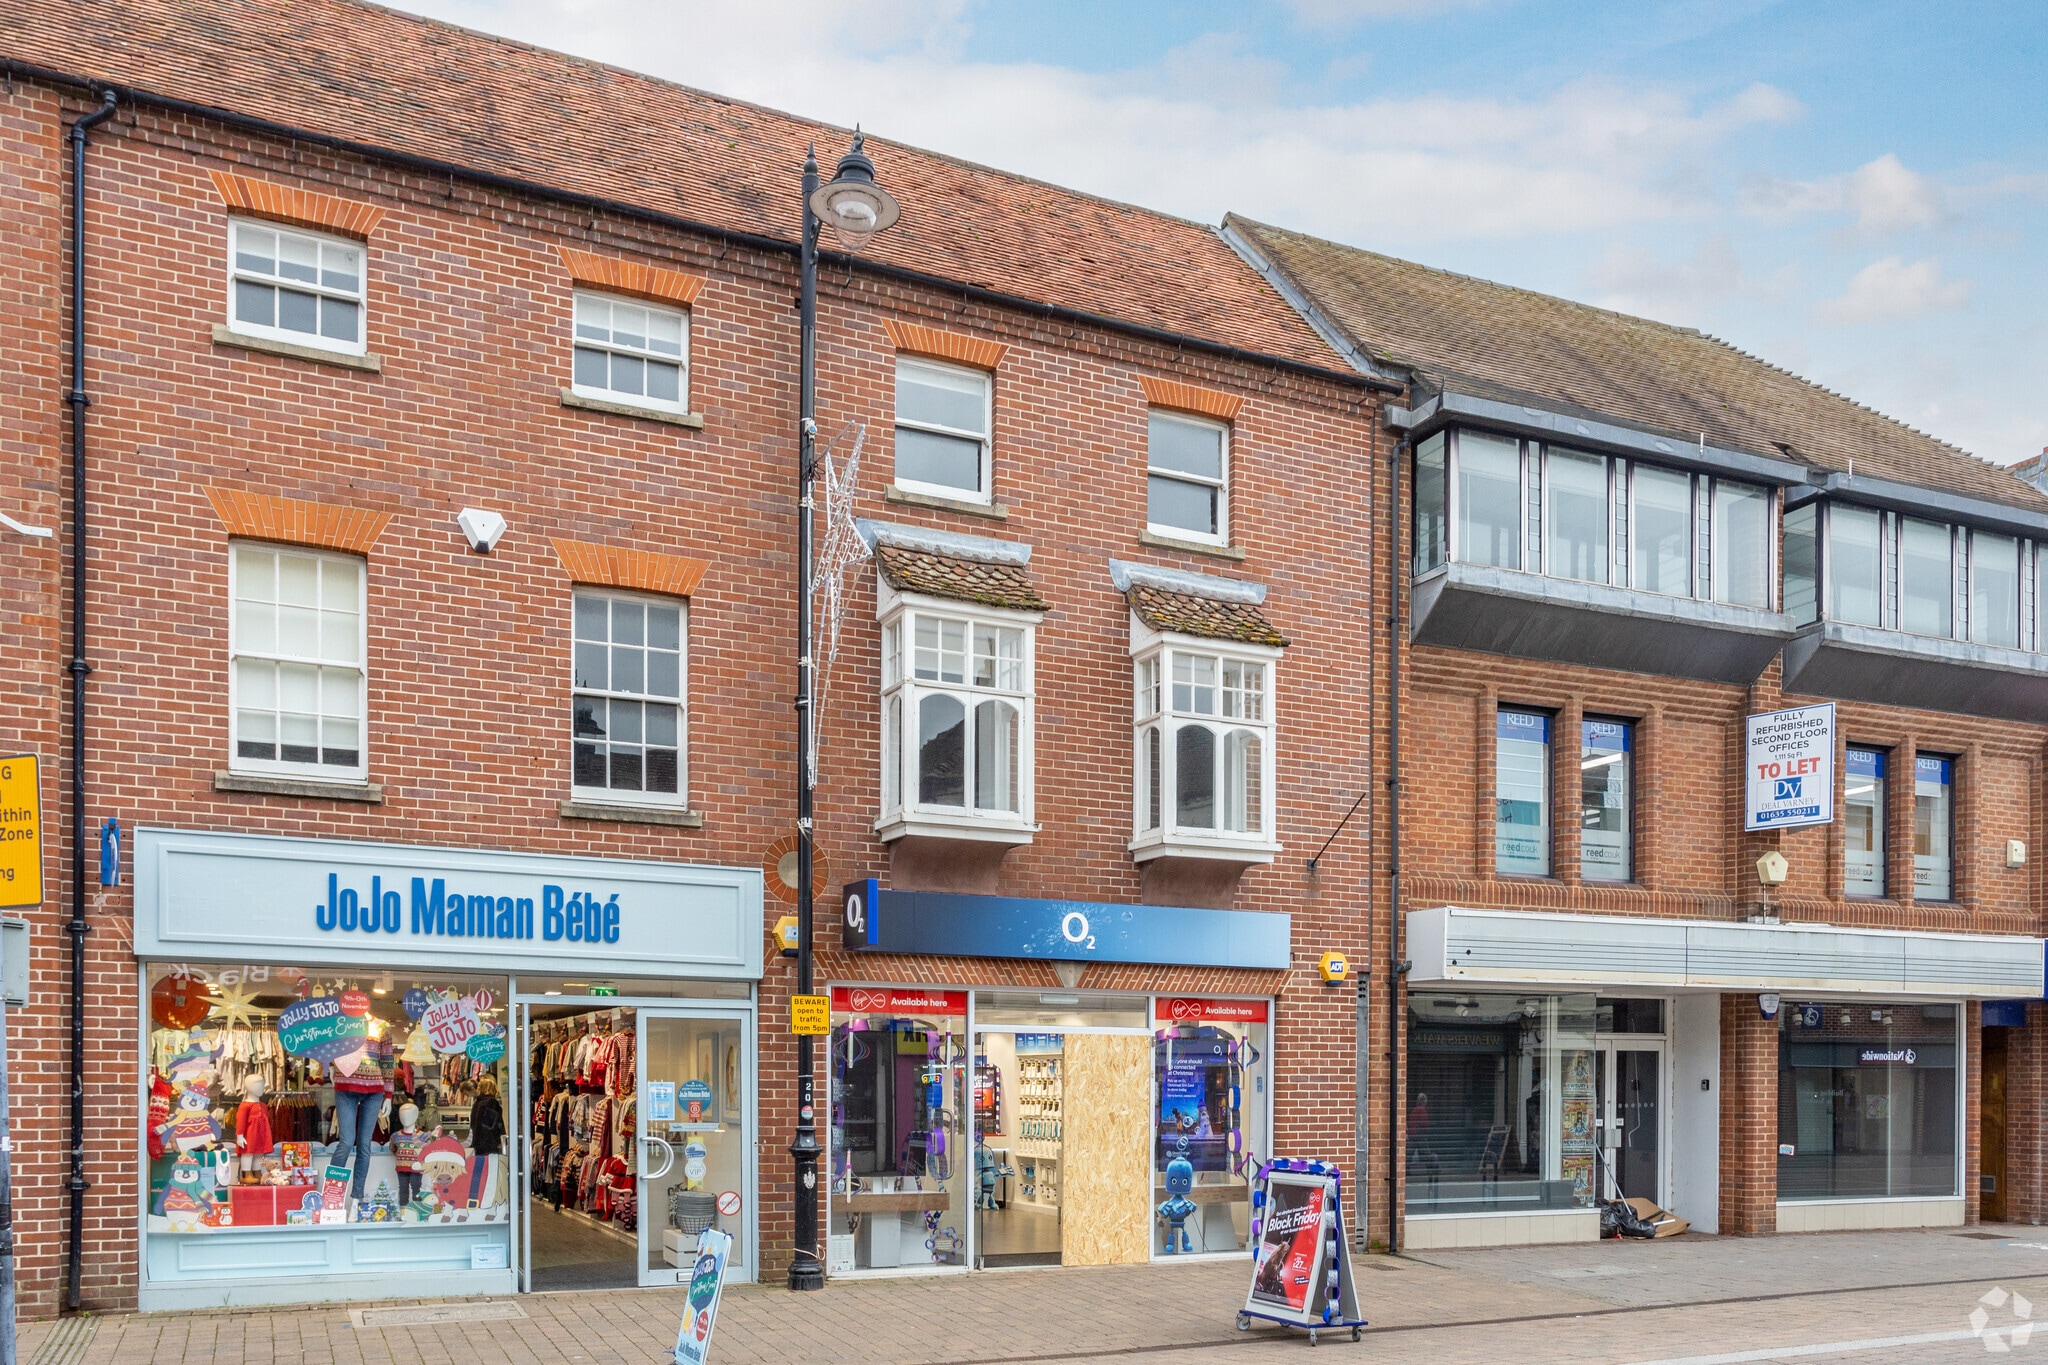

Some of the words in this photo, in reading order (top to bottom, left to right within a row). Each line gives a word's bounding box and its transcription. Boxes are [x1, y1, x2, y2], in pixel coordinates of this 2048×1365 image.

[1506, 713, 1534, 727] REED
[1774, 711, 1804, 722] FULLY
[1590, 722, 1617, 735] REED
[1756, 718, 1823, 735] REFURBISHED
[1752, 733, 1791, 746] SECOND
[1794, 728, 1828, 740] FLOOR
[1768, 740, 1809, 753] OFFICES
[1787, 752, 1795, 760] Sq
[1850, 751, 1872, 763] REED
[1757, 762, 1781, 780] TO
[1787, 757, 1821, 777] LET
[1917, 757, 1939, 770] REED
[1774, 781, 1802, 798] DV
[1761, 800, 1782, 811] DEAL
[1783, 797, 1816, 808] VARNEY
[0, 808, 32, 823] ithin
[1760, 808, 1785, 819] 01635
[1787, 806, 1816, 816] 550211
[316, 872, 401, 933] JoJo
[411, 877, 534, 940] Maman
[543, 884, 621, 944] Bébé
[847, 894, 865, 934] O2
[1061, 912, 1097, 951] O2
[1330, 962, 1344, 971] ADT
[341, 1002, 369, 1010] November
[402, 996, 427, 1012] Have
[794, 998, 827, 1006] BEWARE
[853, 993, 868, 1007] Virgin
[890, 996, 929, 1007] Available
[930, 999, 948, 1008] here
[797, 1008, 814, 1016] open
[1174, 1003, 1187, 1016] Virgin
[1205, 1006, 1237, 1015] Available
[1238, 1007, 1253, 1015] here
[284, 1026, 333, 1053] Christmas
[335, 1016, 366, 1036] Event
[429, 1016, 477, 1049] JOJO
[793, 1024, 811, 1032] from
[812, 1024, 828, 1033] 5pm
[468, 1041, 505, 1059] Christmas
[689, 1168, 702, 1176] VIP
[1268, 1213, 1293, 1232] Black
[1293, 1210, 1322, 1227] Friday
